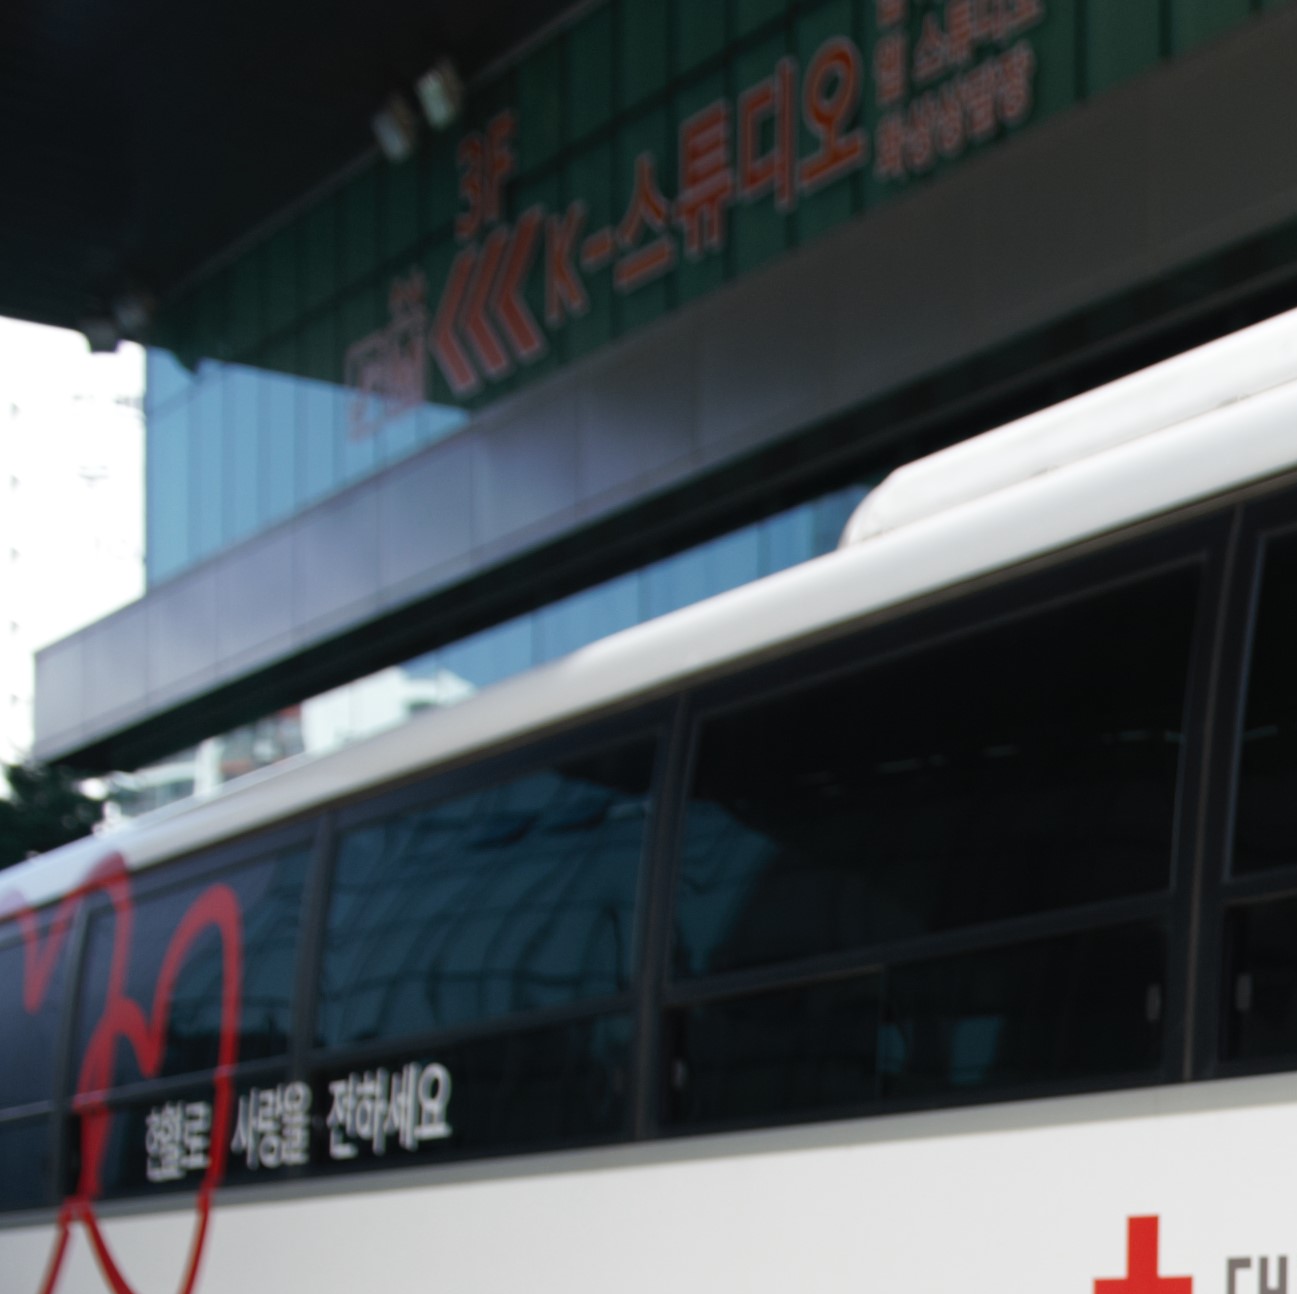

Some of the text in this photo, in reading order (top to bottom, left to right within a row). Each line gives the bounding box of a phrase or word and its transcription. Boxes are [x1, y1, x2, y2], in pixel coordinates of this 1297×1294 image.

[542, 35, 867, 328] K-스튜디오
[145, 1061, 453, 1182] 헌혈로 사랑을 전하세요
